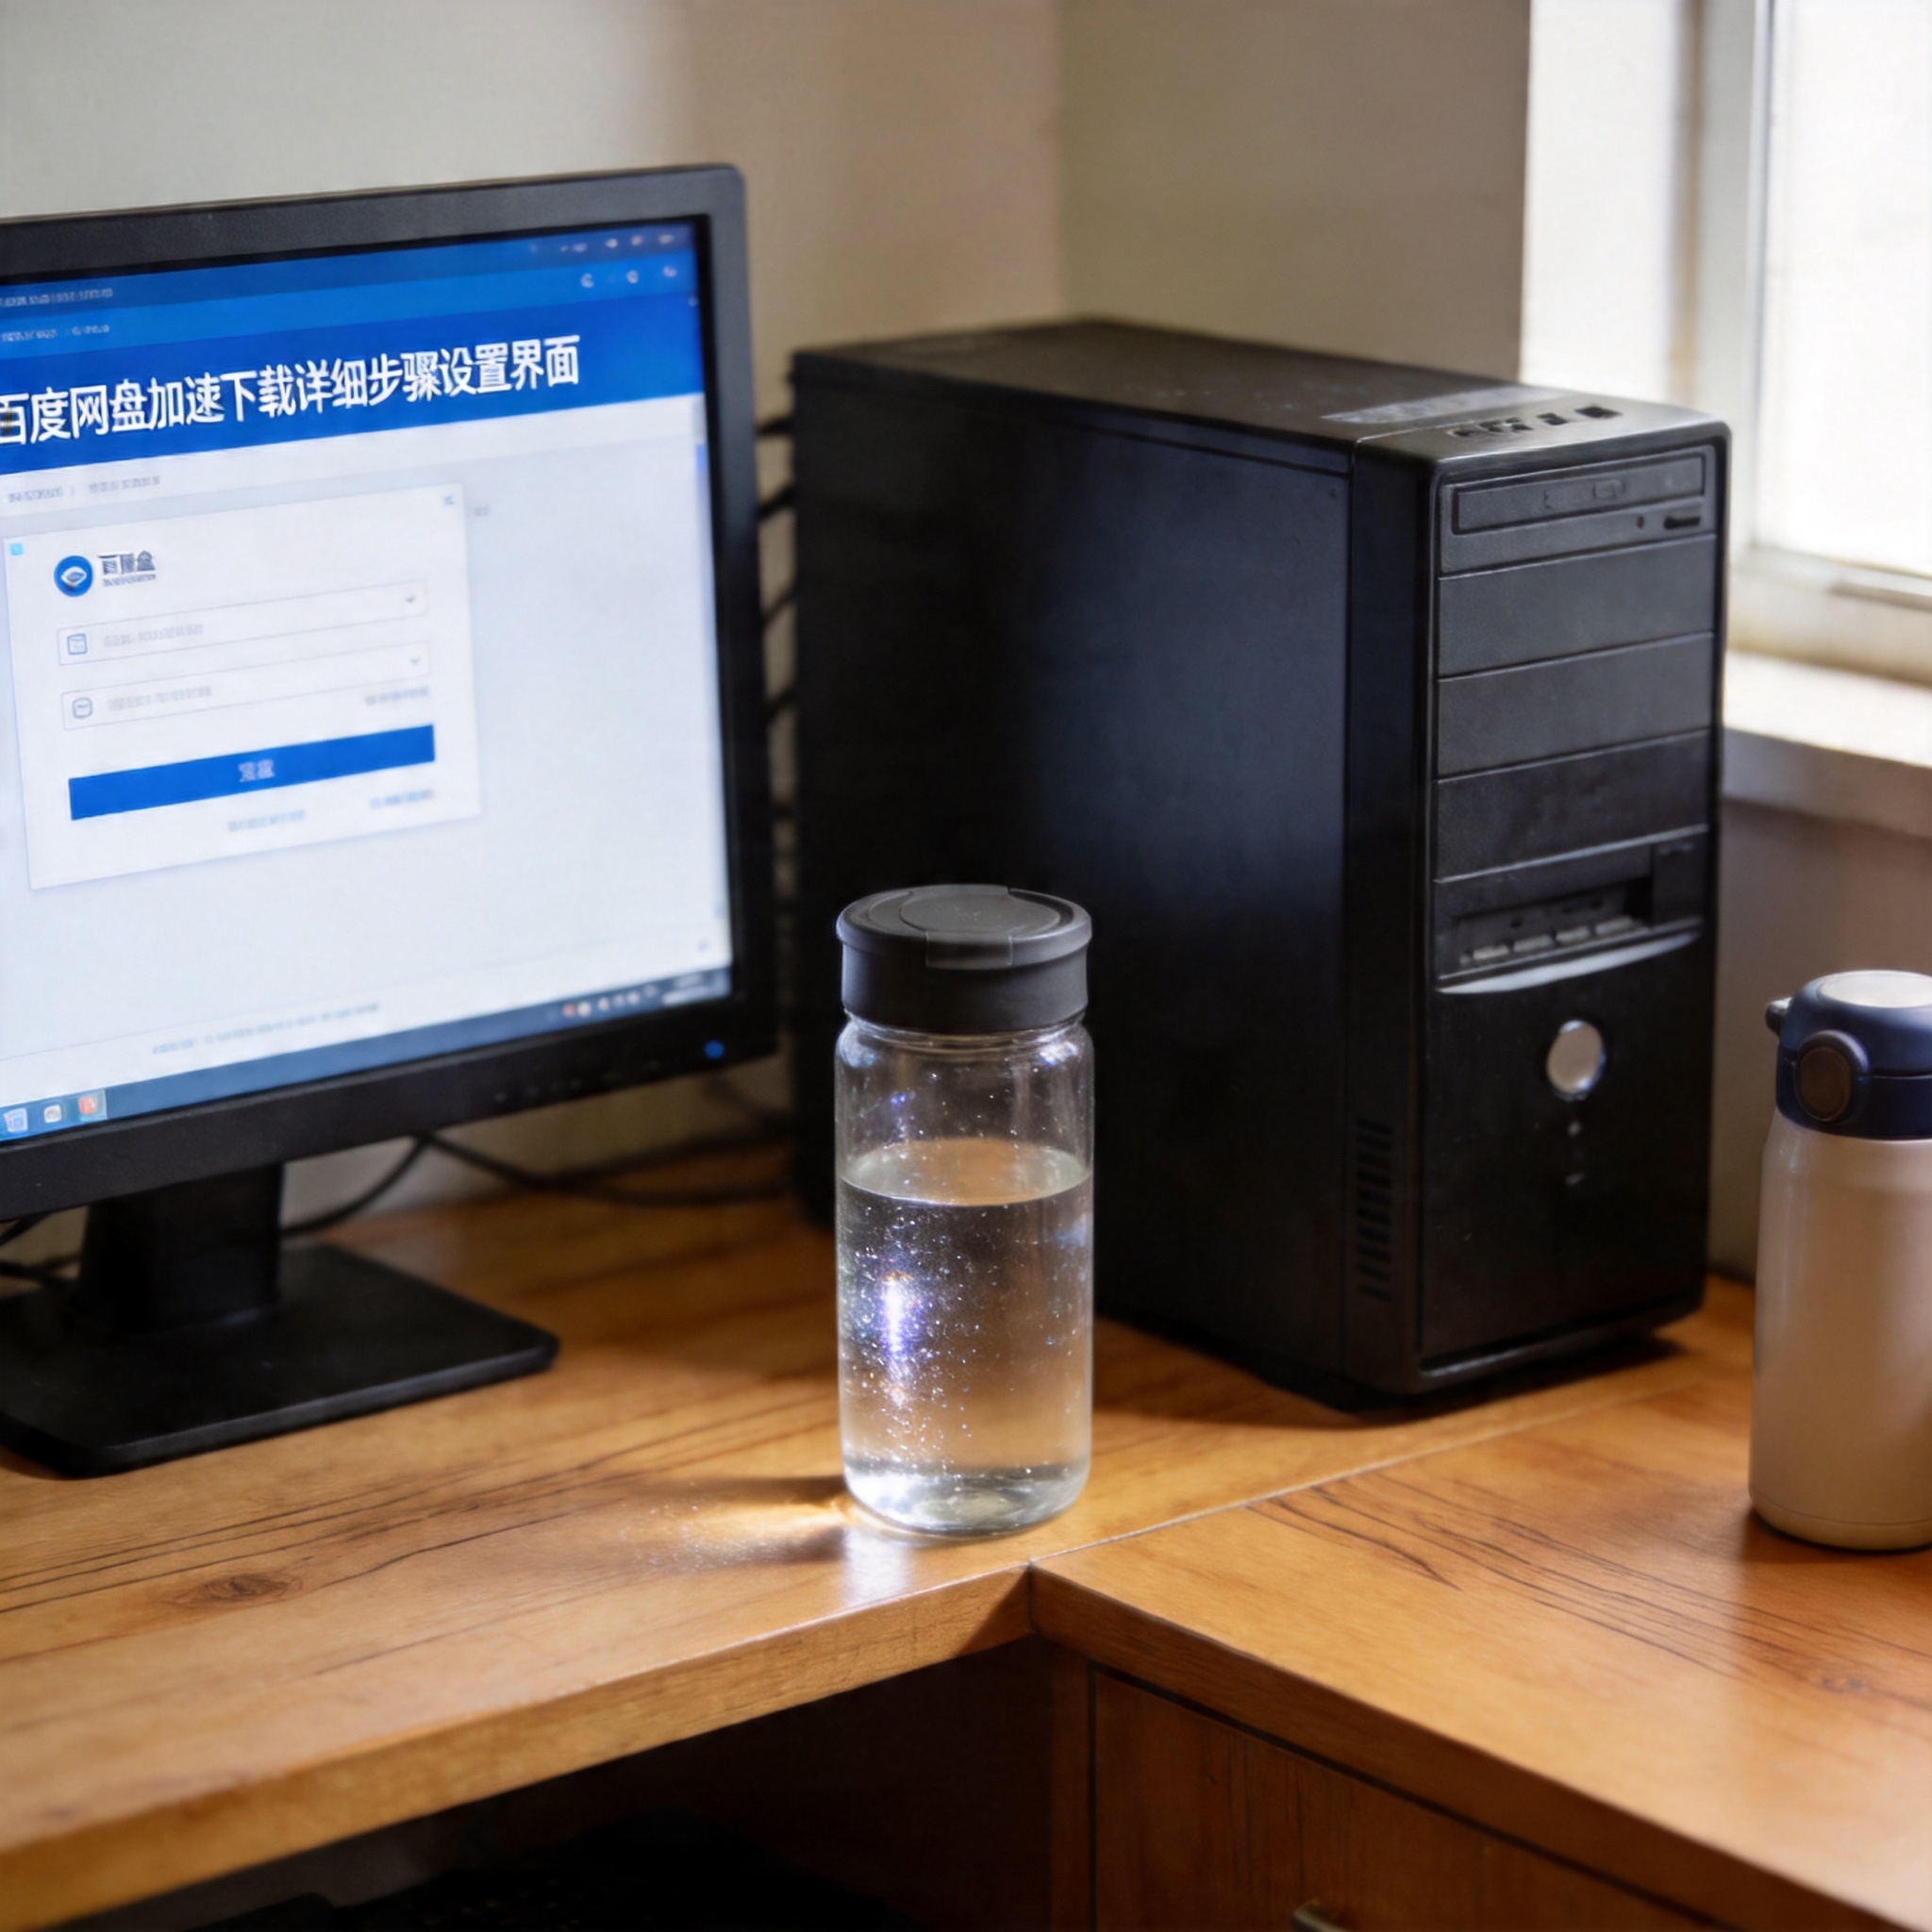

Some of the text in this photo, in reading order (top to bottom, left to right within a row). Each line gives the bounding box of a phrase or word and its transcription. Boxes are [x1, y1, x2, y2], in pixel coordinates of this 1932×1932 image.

[0, 335, 580, 445] 百度网盘加速下载详细步骤设置界面
